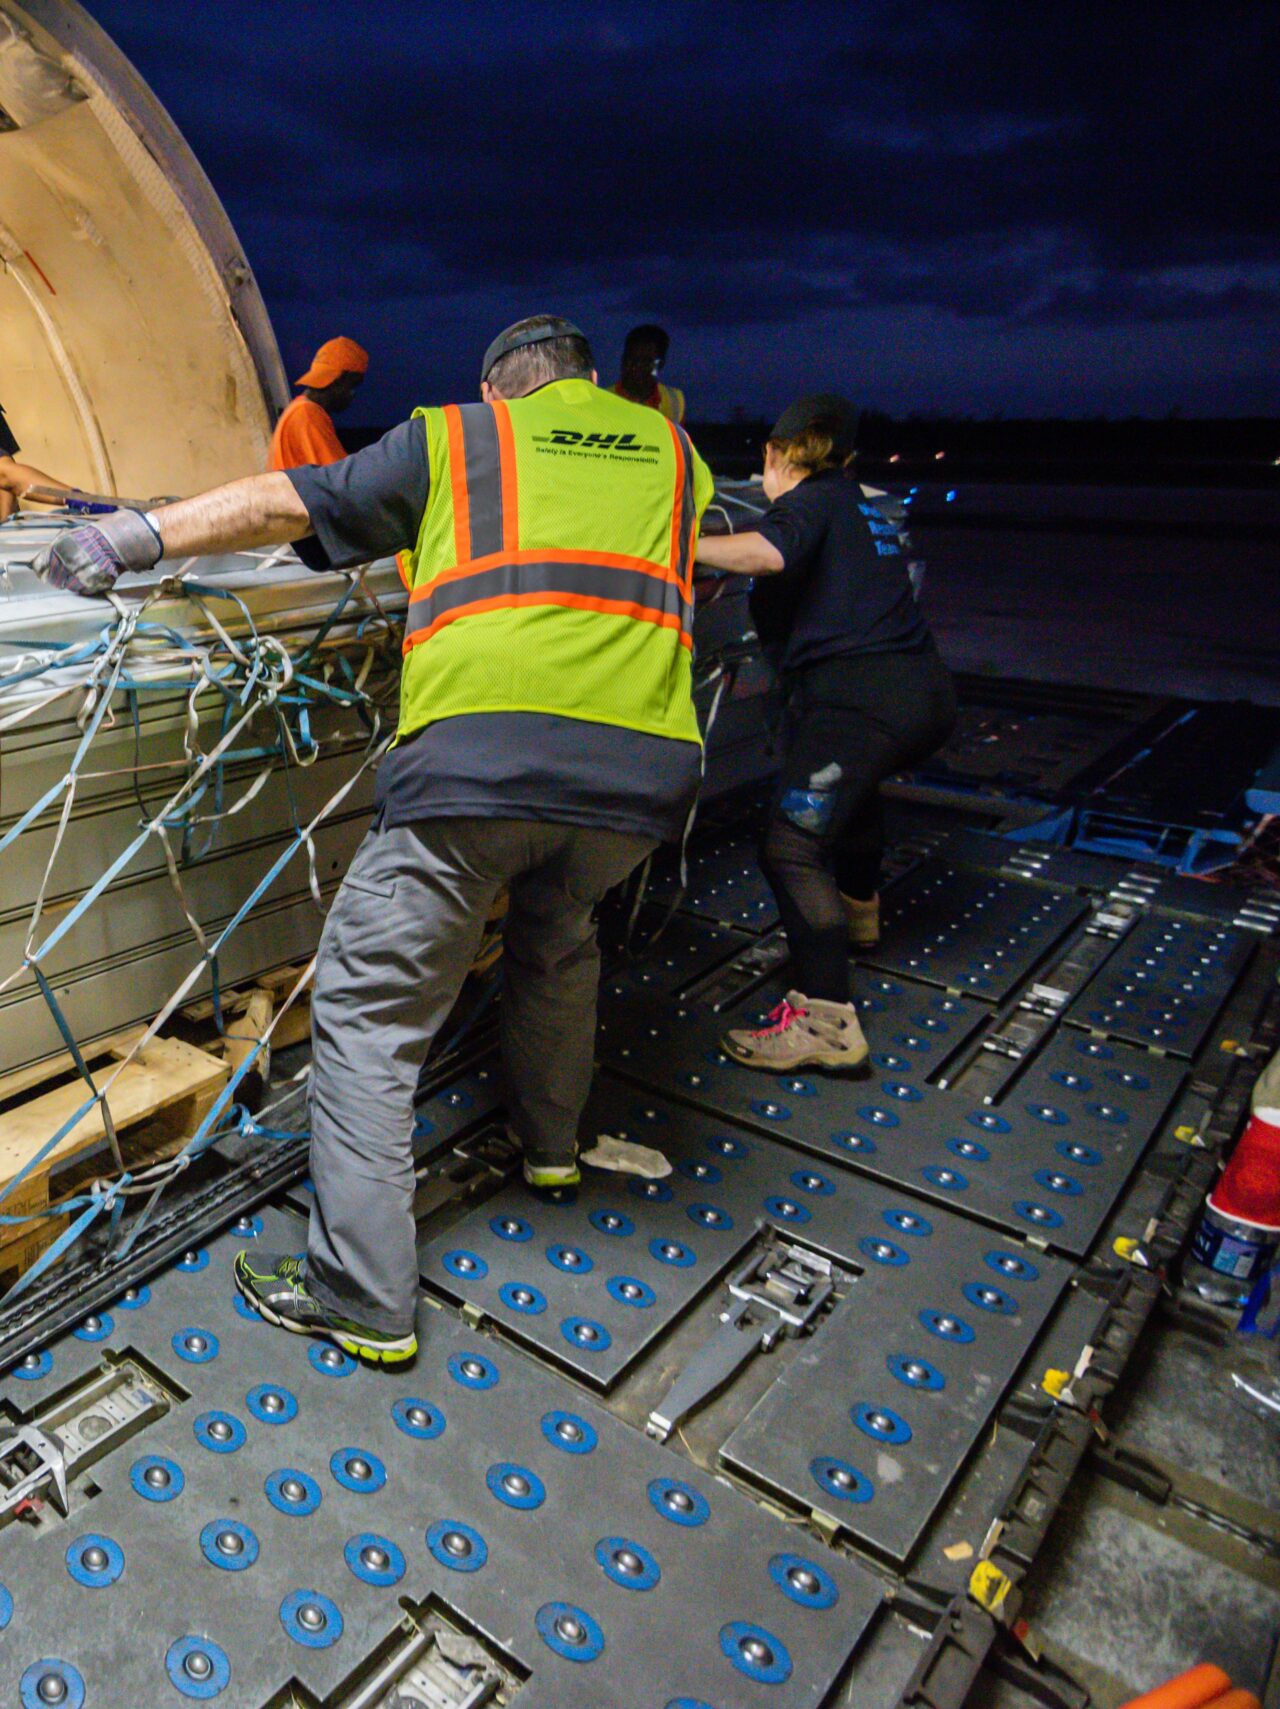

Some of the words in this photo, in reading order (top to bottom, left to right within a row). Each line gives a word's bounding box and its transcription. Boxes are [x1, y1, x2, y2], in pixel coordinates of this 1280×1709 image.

[550, 429, 642, 450] DHL
[535, 446, 558, 456] Safety
[568, 449, 607, 459] Everyone's
[609, 453, 658, 464] Responsibility
